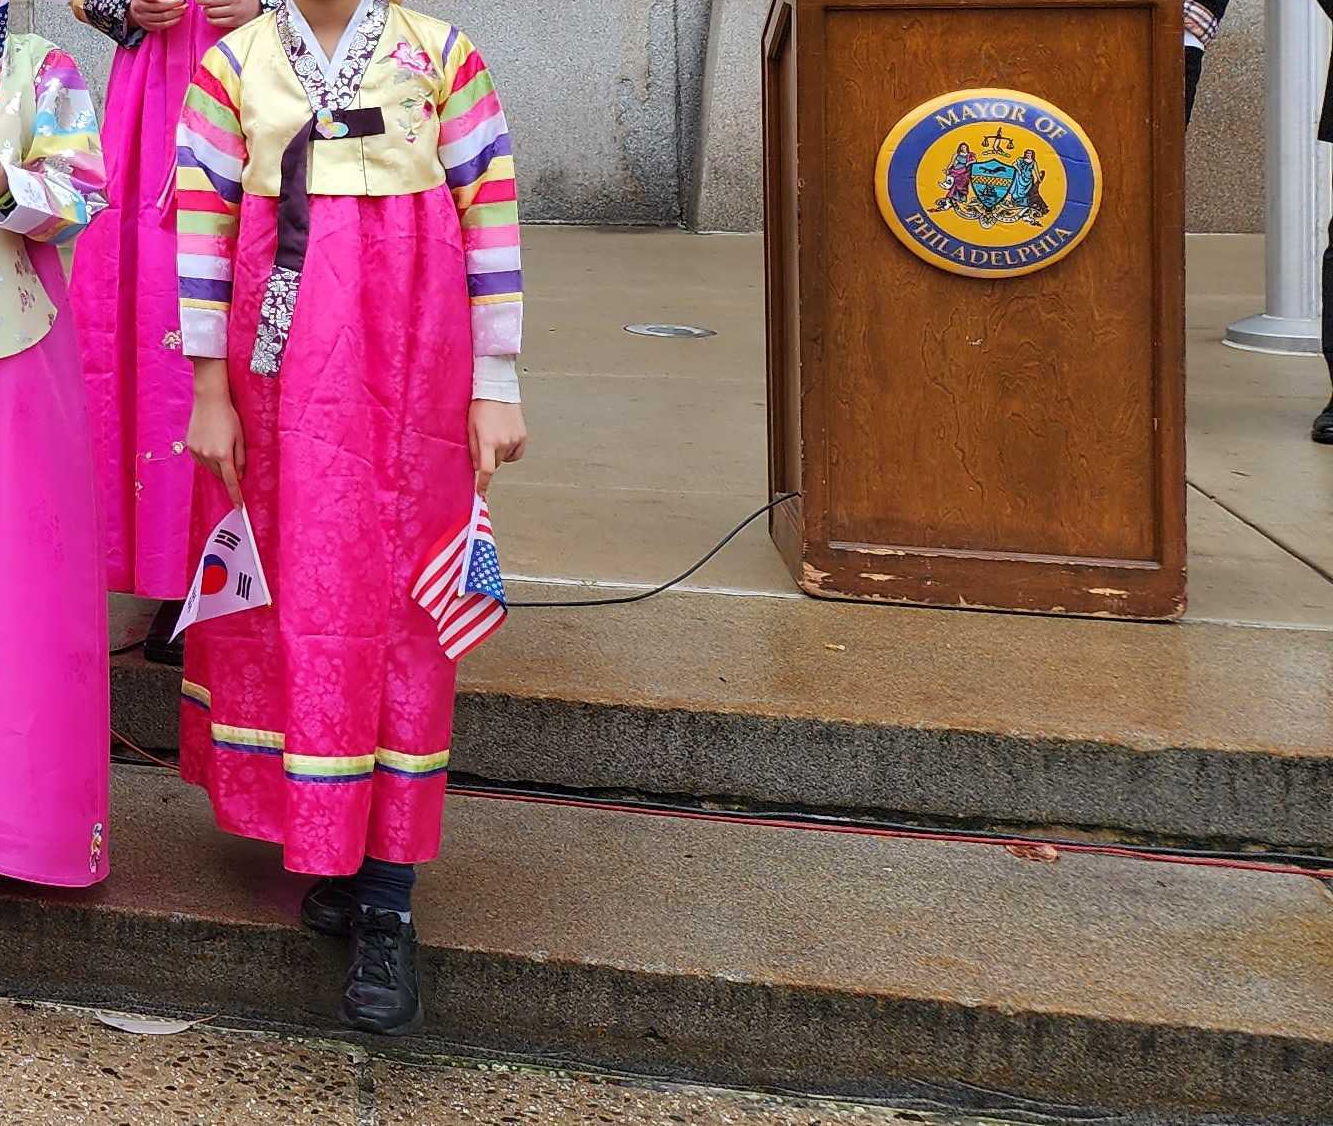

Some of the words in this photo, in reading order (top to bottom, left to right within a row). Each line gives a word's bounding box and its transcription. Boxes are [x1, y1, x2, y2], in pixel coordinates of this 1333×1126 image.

[936, 102, 1025, 129] MAYOR
[1035, 117, 1067, 140] OF
[905, 213, 1073, 266] PHILADELPHIA
